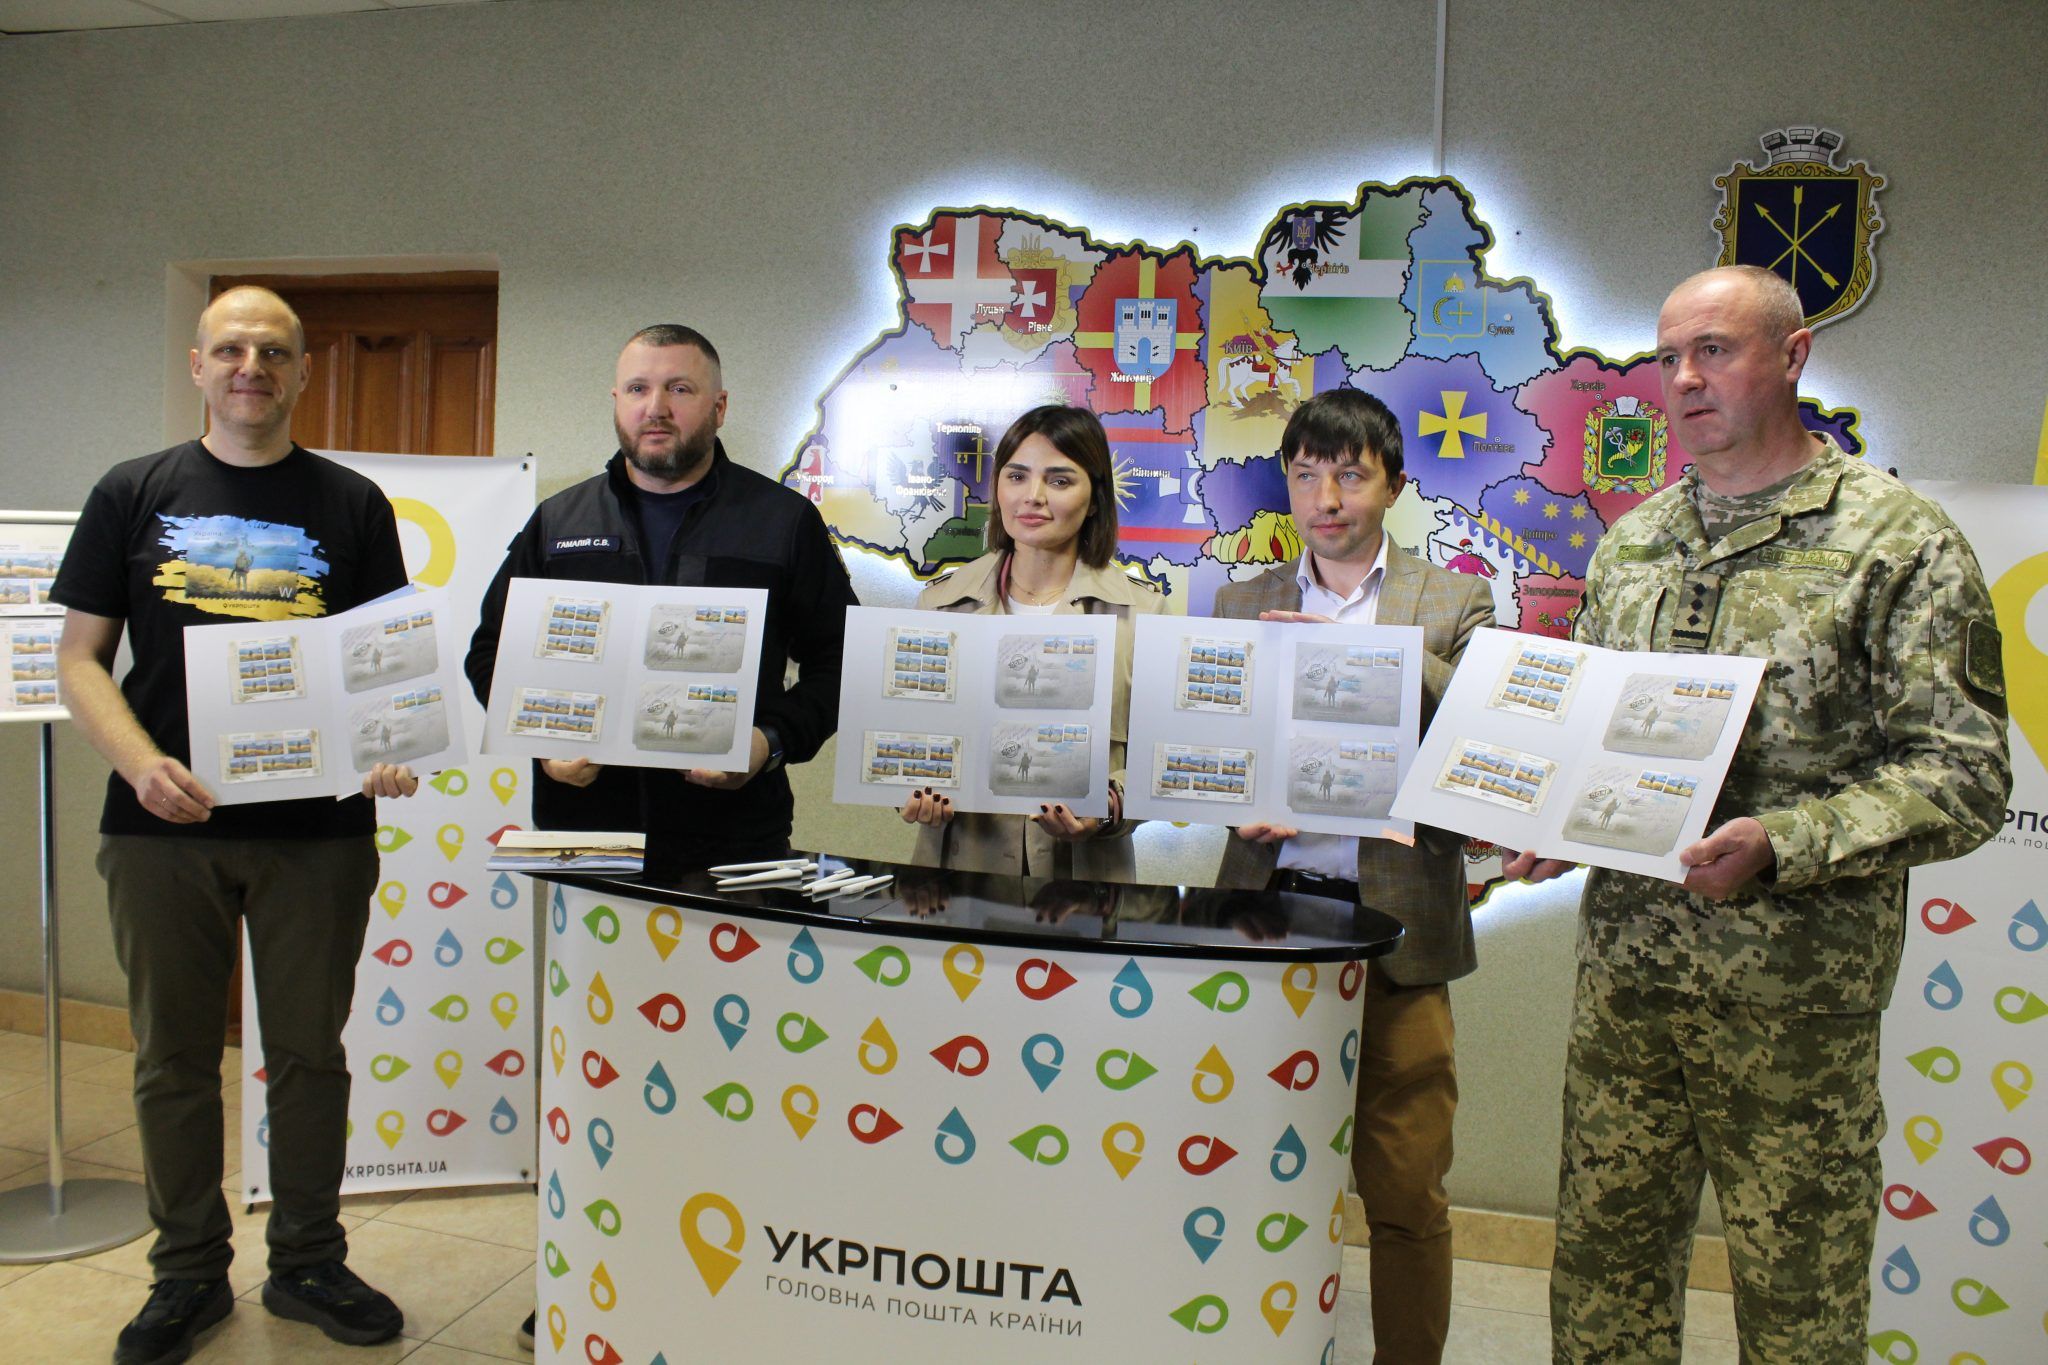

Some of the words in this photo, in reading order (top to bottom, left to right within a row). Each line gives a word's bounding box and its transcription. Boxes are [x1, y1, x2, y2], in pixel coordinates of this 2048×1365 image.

[976, 304, 1004, 317] Луцьк
[1028, 321, 1053, 332] Рівне
[1224, 341, 1253, 354] Київ
[936, 422, 982, 434] Тернопіль
[279, 586, 293, 599] W
[763, 1225, 1083, 1307] УКРПОШТА
[766, 1274, 876, 1312] ГОЛОВНА
[887, 1299, 978, 1326] ПОШТА
[989, 1311, 1083, 1338] КРАЇНИ
